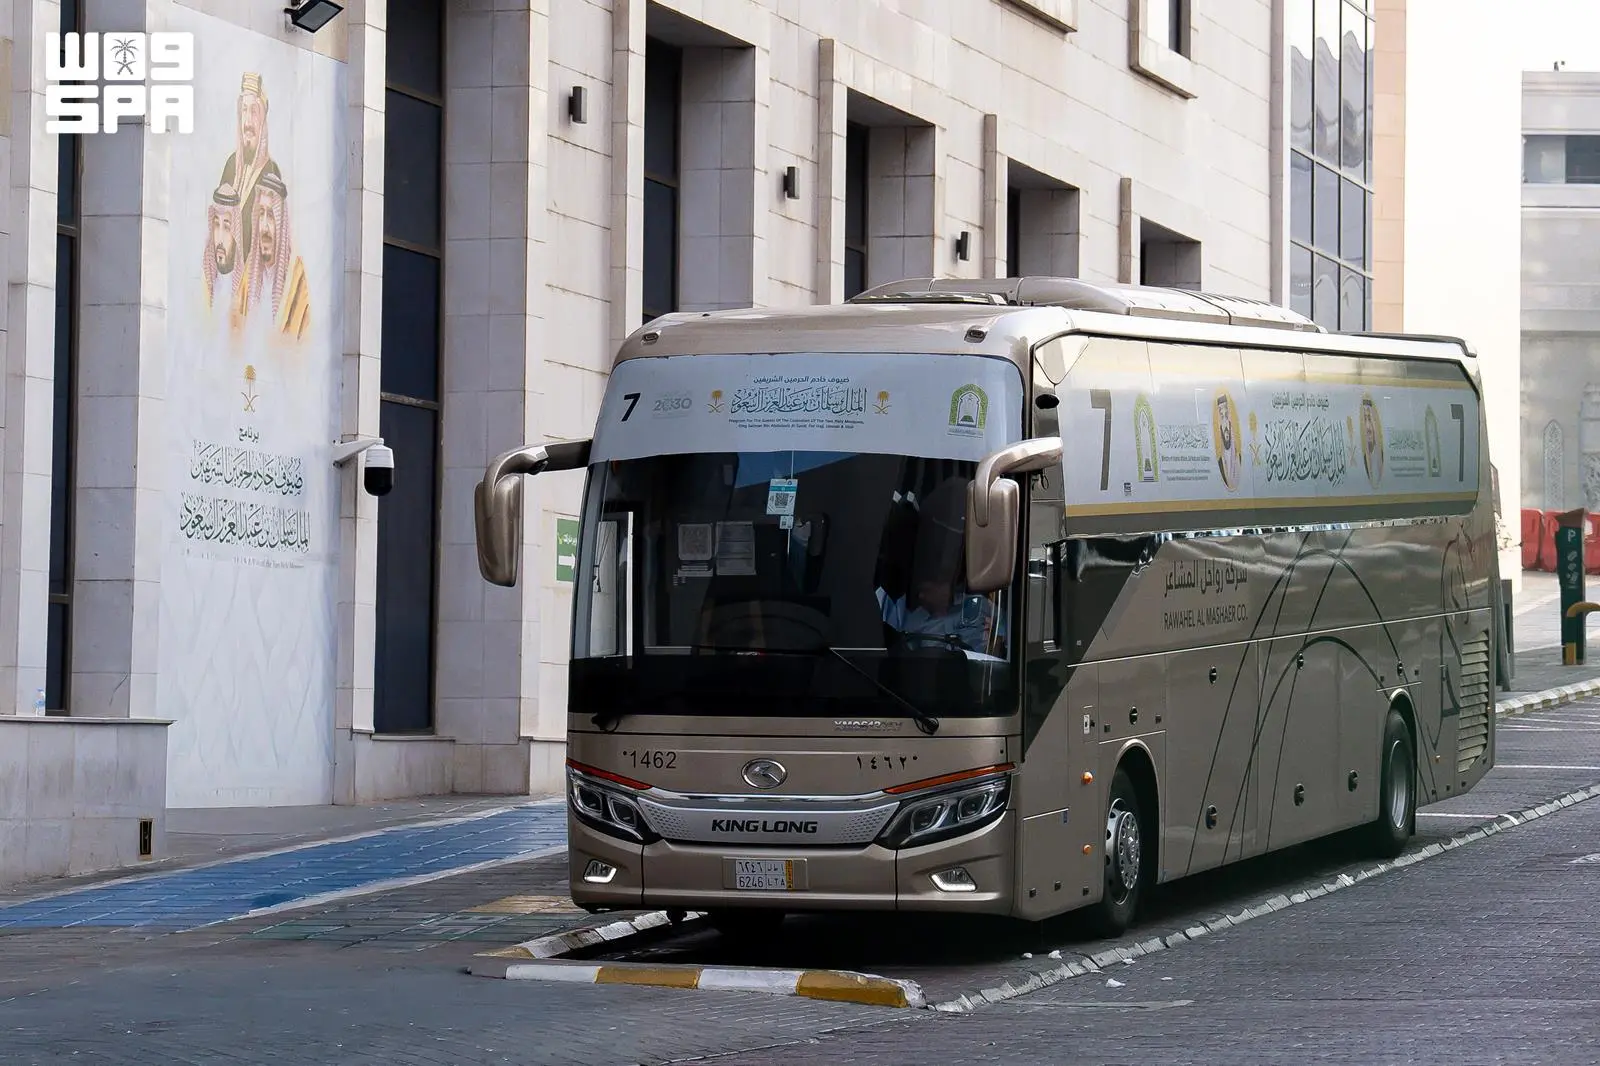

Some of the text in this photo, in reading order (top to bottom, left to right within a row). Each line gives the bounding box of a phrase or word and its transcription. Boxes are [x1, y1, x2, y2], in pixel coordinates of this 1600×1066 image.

[620, 392, 641, 422] 7
[238, 427, 260, 443] برنامج
[1090, 389, 1112, 491] 7
[1450, 404, 1464, 482] 7
[1568, 529, 1576, 542] P
[1164, 559, 1199, 598] المشاعر
[1200, 559, 1224, 594] رواحل
[1164, 604, 1248, 630] RAWAHEL AL MASHAER CO.
[630, 750, 676, 769] 1462
[712, 819, 818, 834] KING LONG
[738, 862, 763, 873] ٦٢٤٦
[739, 876, 764, 888] 6246
